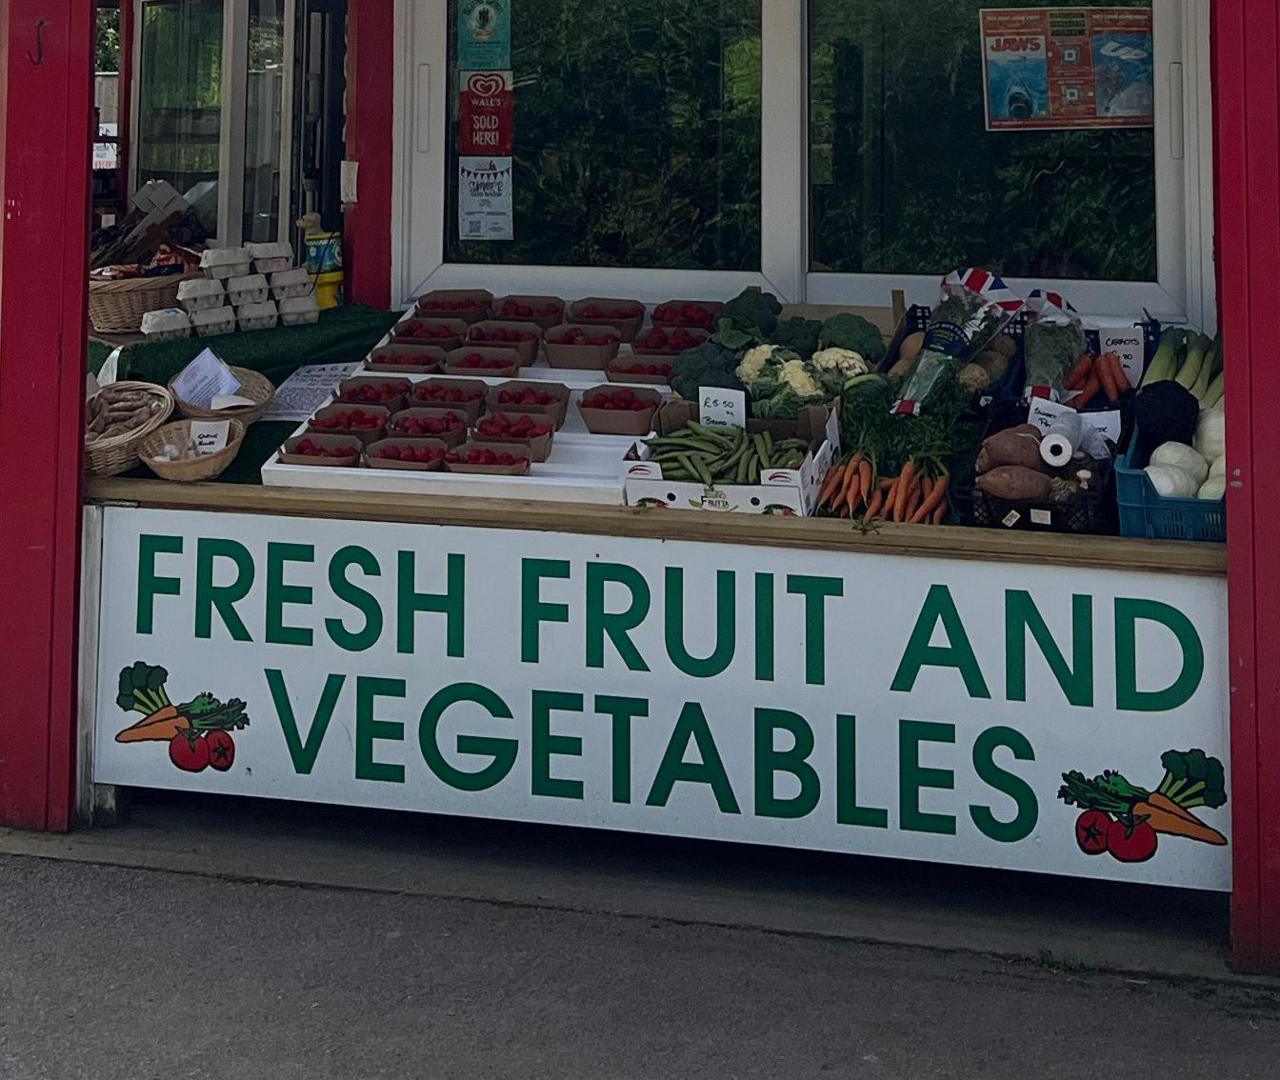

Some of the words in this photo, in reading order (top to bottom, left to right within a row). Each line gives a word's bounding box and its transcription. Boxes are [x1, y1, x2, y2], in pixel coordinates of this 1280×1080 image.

[991, 37, 1040, 51] JAWS
[472, 96, 501, 107] WALL'S
[472, 115, 499, 130] SOLD
[472, 130, 499, 145] HERE!
[136, 533, 466, 658] FRESH
[521, 557, 845, 686] FRUIT
[891, 584, 1205, 712] AND
[265, 668, 1040, 843] VEGETABLES
